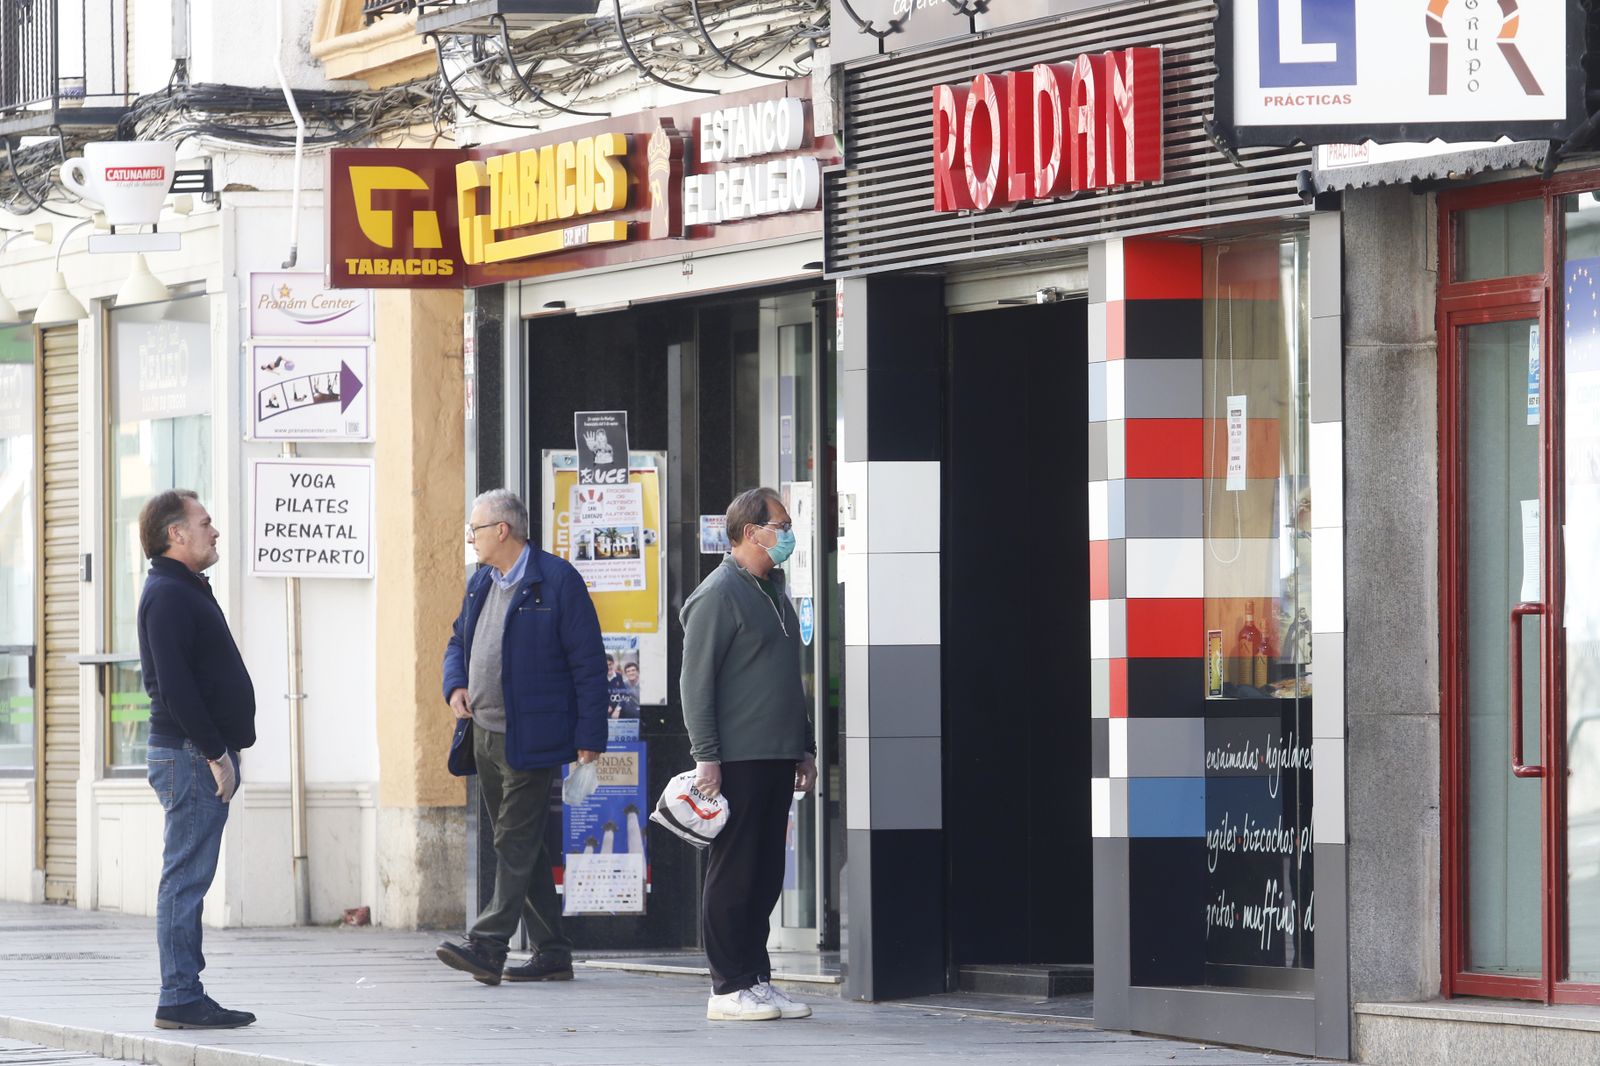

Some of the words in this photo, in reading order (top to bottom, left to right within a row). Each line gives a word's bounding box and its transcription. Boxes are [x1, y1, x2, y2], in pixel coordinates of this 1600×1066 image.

[1264, 92, 1352, 106] PRÁCTICAS
[701, 98, 803, 163] ESTANCO
[932, 46, 1163, 212] ROLDAN
[487, 133, 627, 230] TABACOS
[685, 174, 720, 226] EL
[715, 156, 819, 220] REALEJO
[345, 258, 454, 276] TABACOS
[311, 293, 355, 310] Center
[290, 473, 336, 488] YOGA
[275, 498, 349, 513] PILATES
[264, 523, 357, 539] PRENATAL
[258, 548, 365, 564] POSTPARTO
[1206, 740, 1259, 770] ensaimadas
[1243, 813, 1294, 854] bizcochos
[1242, 879, 1296, 950] muffins
